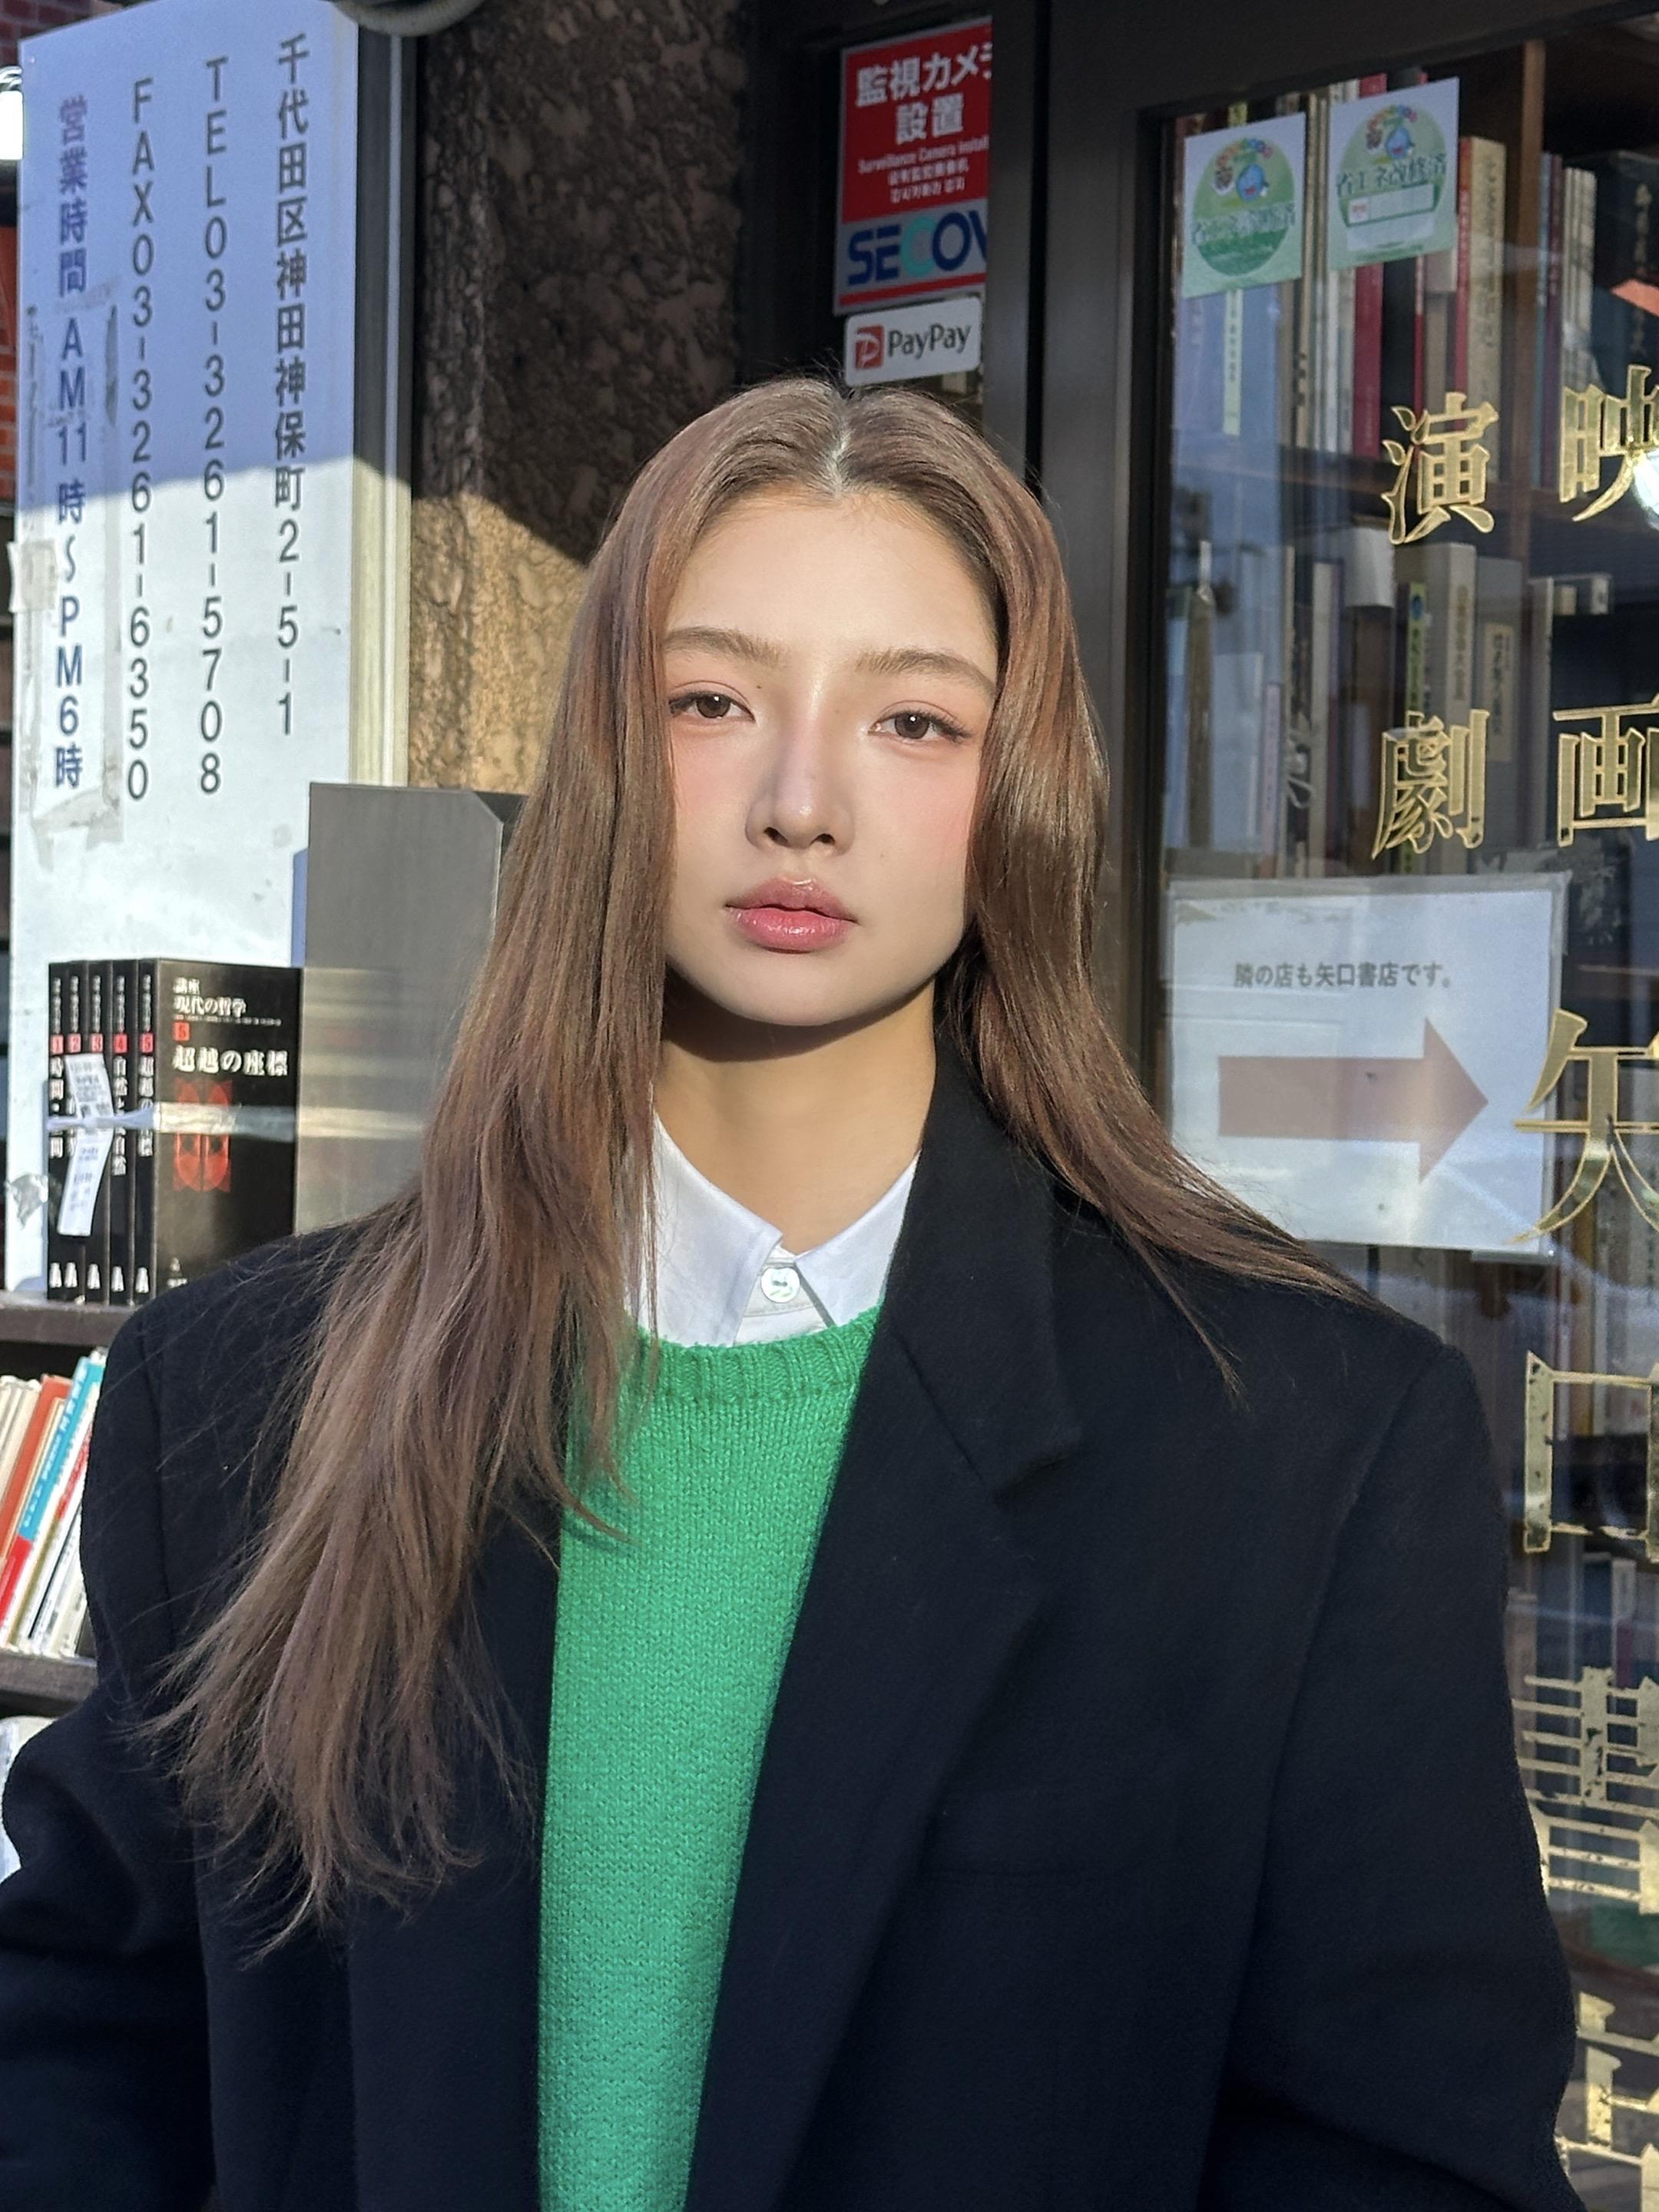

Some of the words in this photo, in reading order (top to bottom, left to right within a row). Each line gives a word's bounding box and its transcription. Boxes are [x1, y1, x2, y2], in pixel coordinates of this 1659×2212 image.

[896, 92, 964, 144] 設置
[887, 323, 971, 359] PayPay
[1371, 390, 1500, 859] 演劇
